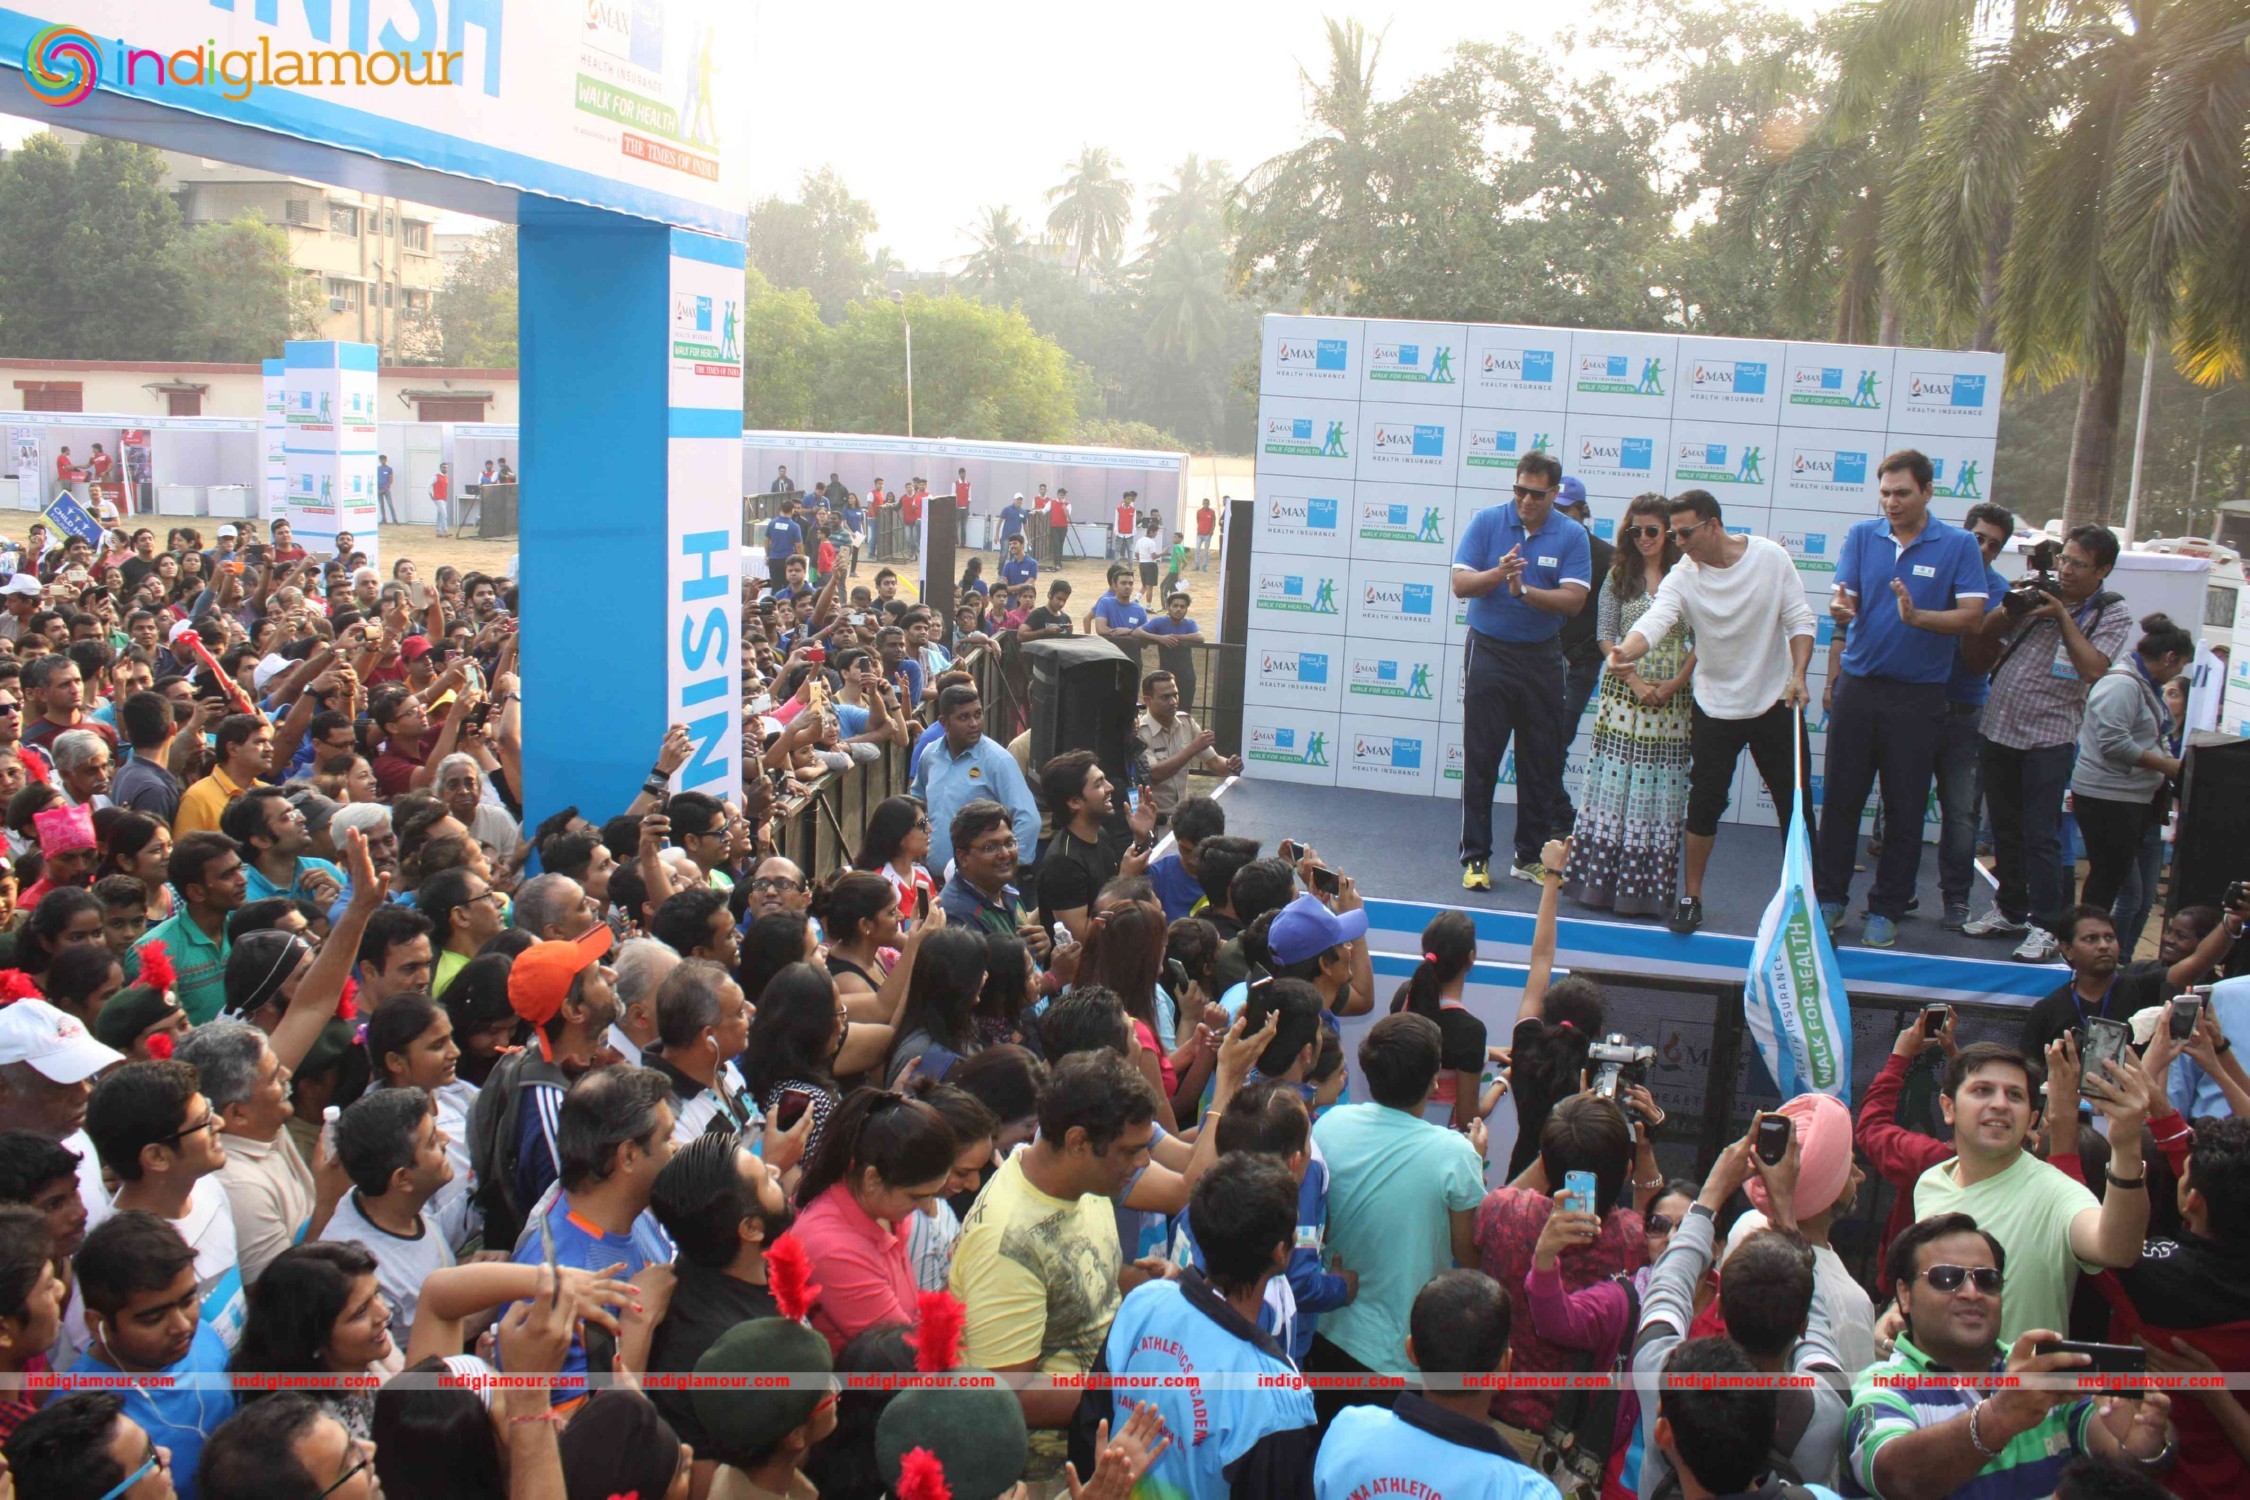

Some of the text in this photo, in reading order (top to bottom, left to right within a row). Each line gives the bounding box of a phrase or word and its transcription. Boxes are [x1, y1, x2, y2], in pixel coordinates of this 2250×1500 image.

[580, 53, 663, 94] HEALTH INSURANCE
[578, 81, 676, 133] WALK FOR HEALTH
[625, 136, 645, 154] THE
[647, 143, 677, 166] TIMES
[678, 152, 691, 169] OF
[675, 345, 720, 359] WALK FOR HEALTH
[1289, 348, 1315, 359] MAX
[1380, 350, 1398, 358] MAX
[1494, 359, 1521, 370] MAX
[1371, 371, 1387, 379] WALK
[1402, 373, 1426, 381] HEALTH
[1705, 371, 1733, 382] MAX
[1510, 383, 1551, 391] INSURANCE
[1610, 385, 1635, 393] HEALTH
[1922, 383, 1950, 394] MAX
[1722, 395, 1764, 403] INSURANCE
[1906, 406, 1982, 416] HEALTH INSURANCE
[1275, 424, 1292, 432] MAX
[1385, 434, 1411, 444] MAX
[1592, 447, 1619, 458] MAX
[1402, 457, 1441, 465] INSURANCE
[1500, 459, 1518, 470] HEALT
[1804, 460, 1832, 471] MAX
[1608, 471, 1649, 479] INSURANCE
[1709, 473, 1734, 481] HEALTH
[1821, 484, 1863, 492] INSURANCE
[1281, 506, 1306, 517] MAX
[1370, 509, 1387, 517] MAX
[1297, 529, 1335, 537] INSURANCE
[1392, 532, 1416, 540] HEALTH
[1375, 591, 1401, 602] MAX
[1391, 614, 1431, 622] INSURANCE
[1272, 660, 1297, 671] MAX
[1361, 664, 1377, 672] MAX
[1288, 683, 1326, 691] INSURANCE
[1258, 732, 1274, 740] MAX
[1366, 744, 1391, 755] MAX
[1279, 754, 1302, 762] HEALTH
[1381, 767, 1420, 776] INSURANCE
[1773, 954, 1795, 1035] INSURANCE
[1788, 922, 1830, 1084] WALK FOR HEALTH
[1142, 1336, 1209, 1448] ATHLETICS CADEM
